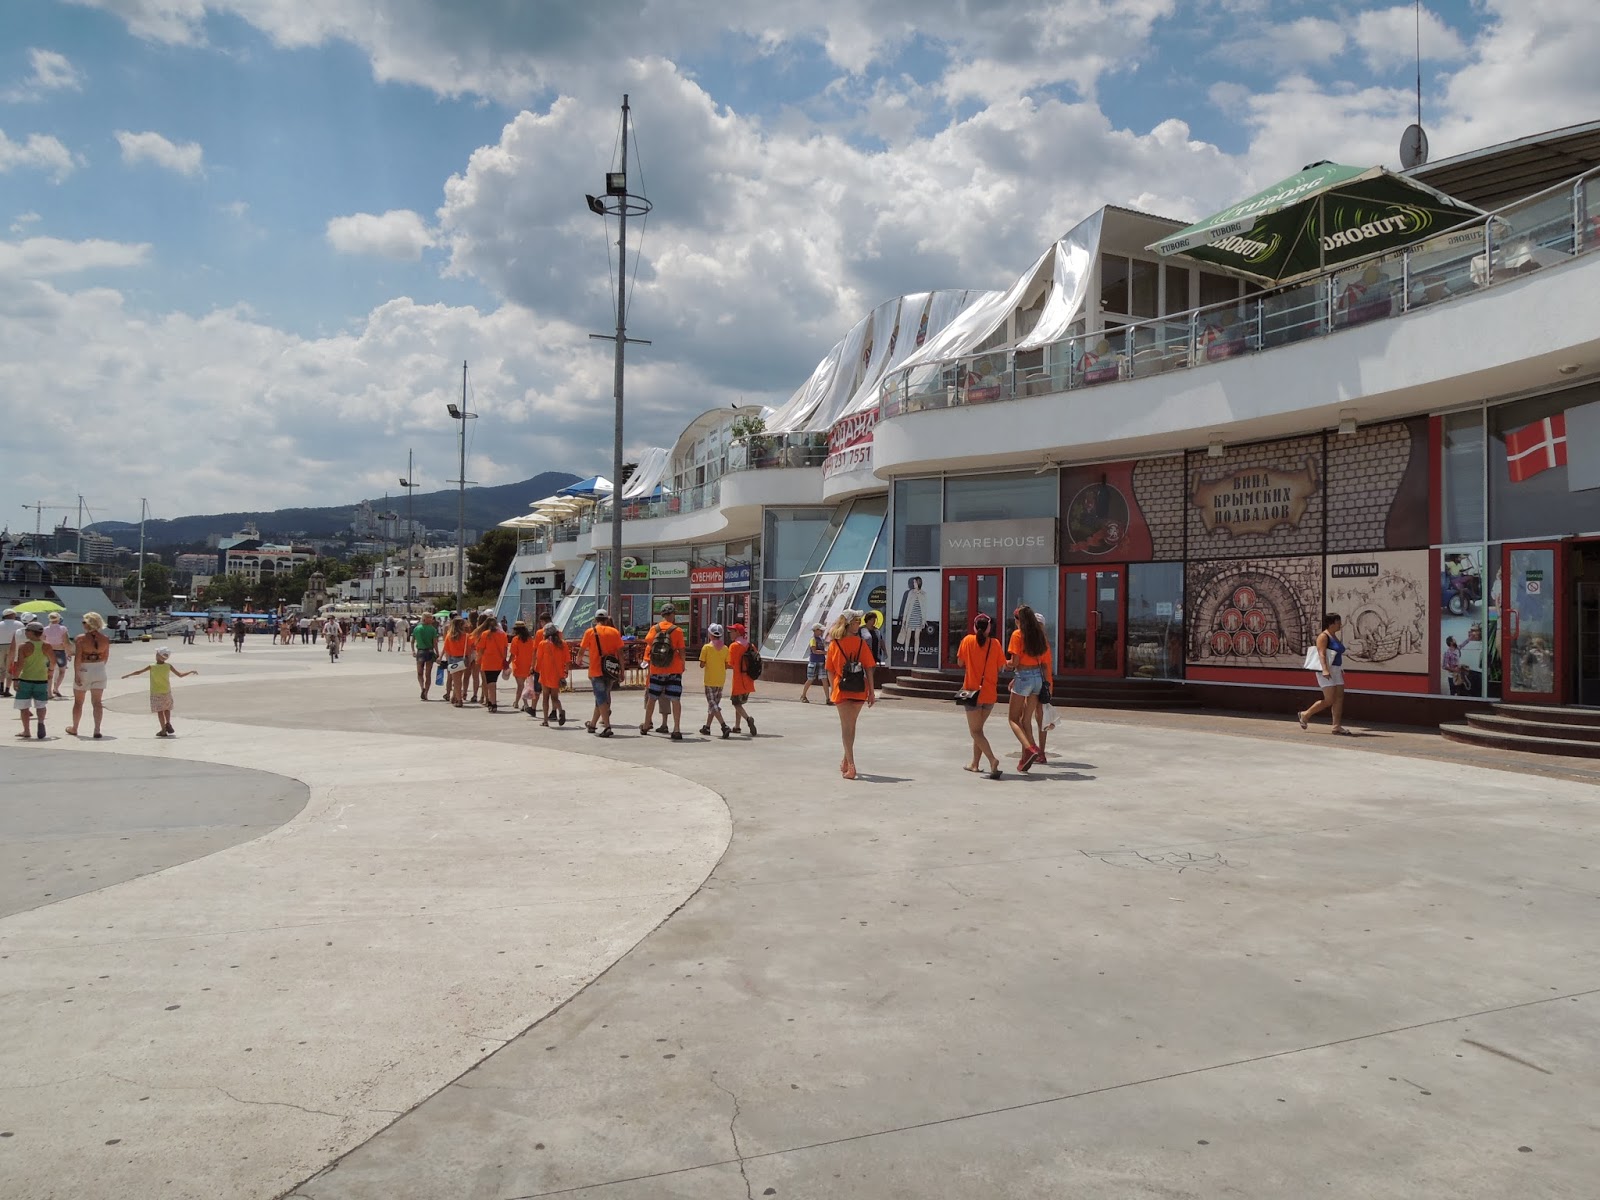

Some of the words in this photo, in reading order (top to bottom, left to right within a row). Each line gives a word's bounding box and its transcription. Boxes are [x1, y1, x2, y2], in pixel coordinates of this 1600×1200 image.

[1233, 176, 1325, 217] TUBORG
[1211, 222, 1242, 239] TUBORG
[1161, 238, 1190, 254] TUBORG
[849, 446, 871, 465] 7551
[1233, 473, 1270, 490] ВИНА
[1213, 487, 1291, 508] КРЫМСКИХ
[1214, 504, 1290, 524] ПОДВАЛОВ
[948, 535, 1045, 549] WAREHOUSE
[691, 570, 724, 583] СУВЕНИРЫ
[1333, 564, 1377, 576] ПРОДУКТЫ
